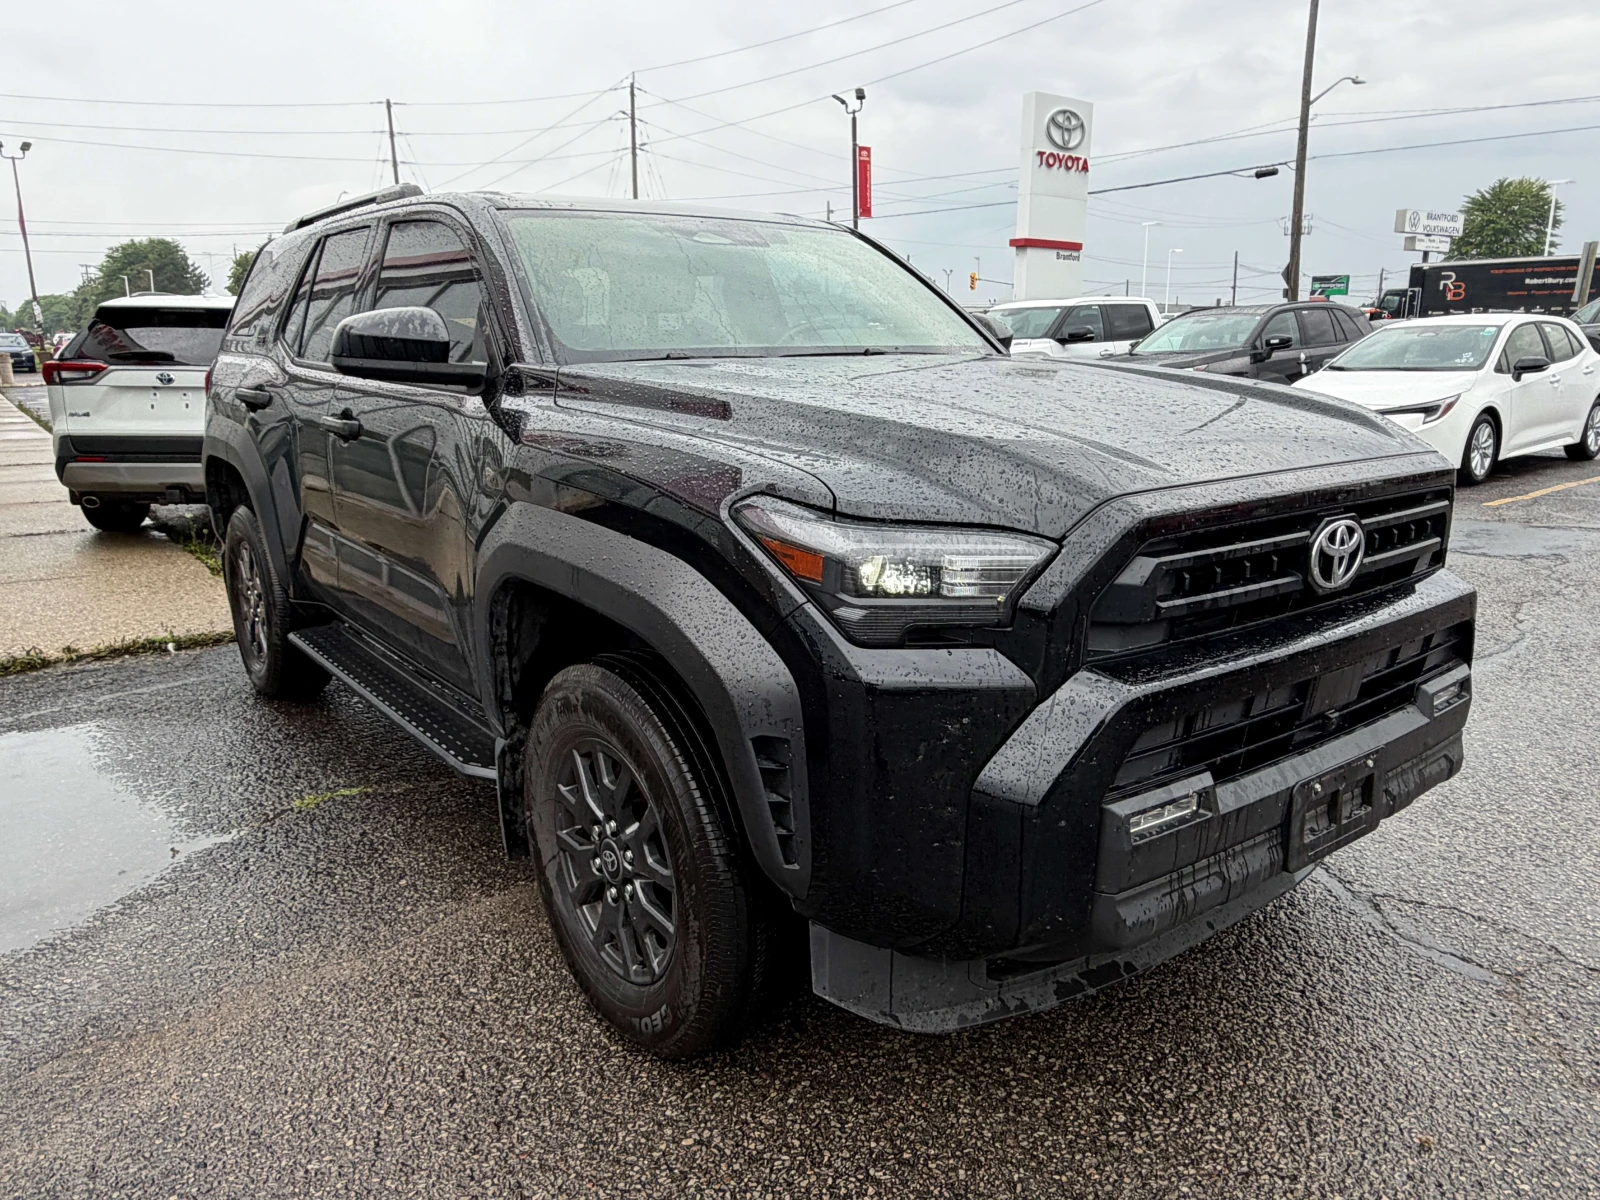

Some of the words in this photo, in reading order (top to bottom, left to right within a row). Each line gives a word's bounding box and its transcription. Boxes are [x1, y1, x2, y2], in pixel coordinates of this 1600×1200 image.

[1036, 150, 1089, 173] TOYOTA
[1426, 212, 1459, 223] BRANTFORD
[1422, 224, 1460, 235] VOLKSWAGEN
[1056, 251, 1081, 262] Brantford
